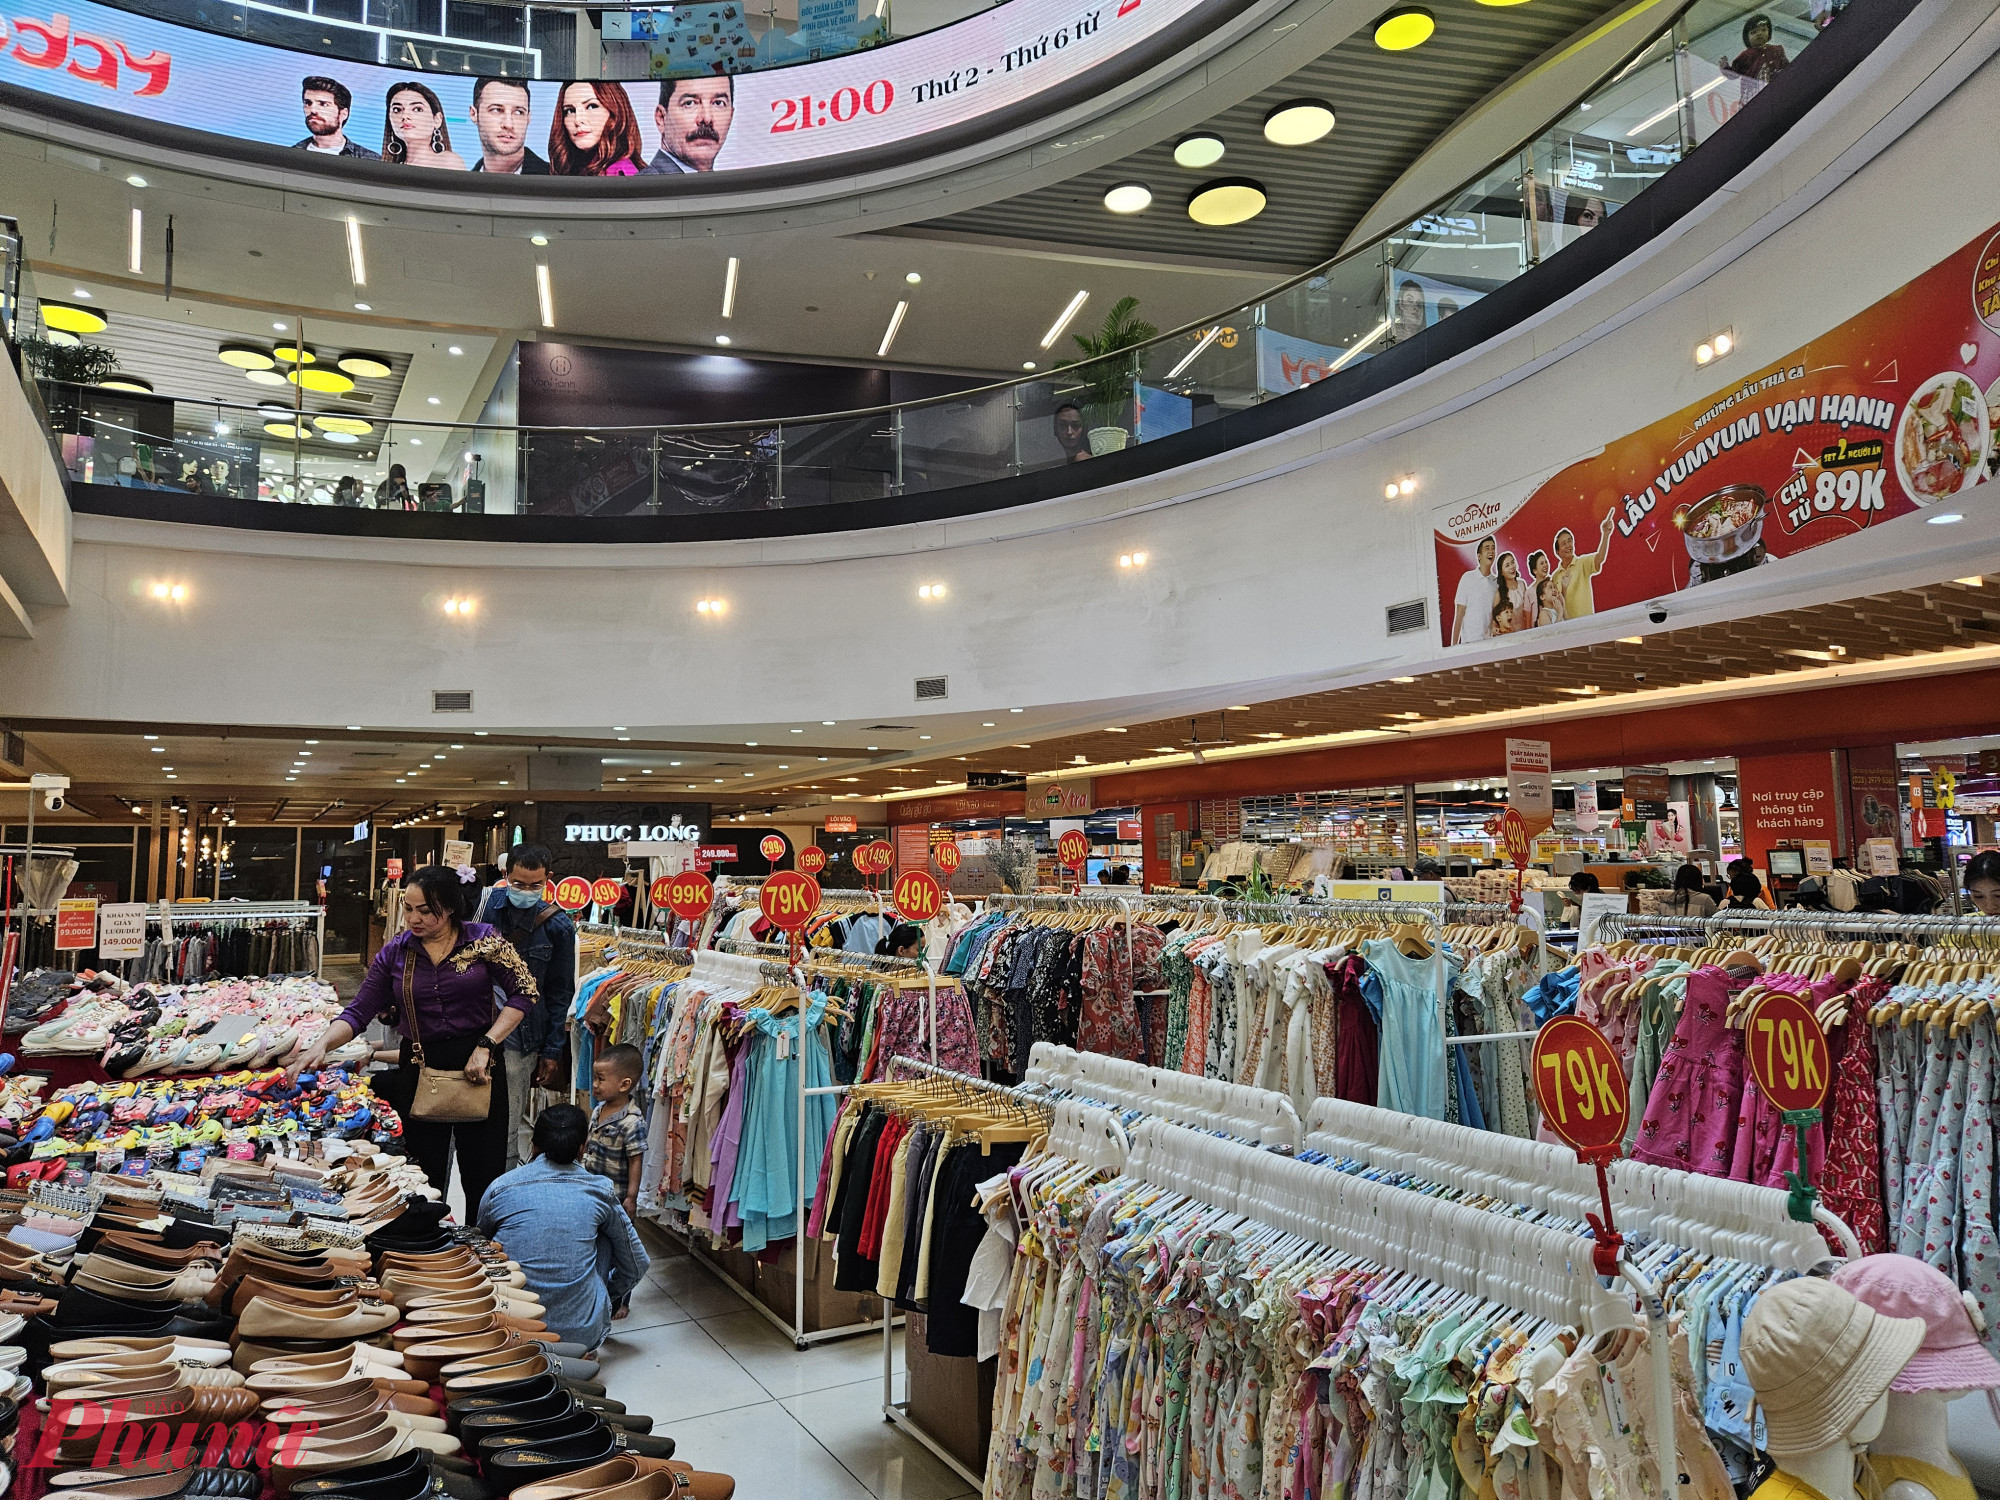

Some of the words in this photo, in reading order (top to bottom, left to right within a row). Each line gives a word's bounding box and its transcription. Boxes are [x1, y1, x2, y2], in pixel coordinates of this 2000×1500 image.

[770, 79, 894, 133] 21:00
[911, 72, 960, 103] Thứ
[965, 67, 979, 88] 2
[1001, 36, 1048, 73] Thứ
[1054, 28, 1069, 49] 6
[1075, 10, 1101, 40] từ
[1787, 365, 1805, 380] GA
[1823, 453, 1836, 463] SET
[1837, 438, 1848, 460] 2
[1617, 487, 1656, 537] LẨU
[1655, 412, 1761, 494] YUMYUM
[1764, 397, 1816, 433] VẠN
[1821, 394, 1895, 431] HẠNH
[1780, 469, 1808, 506] CHỈ
[1814, 468, 1887, 512] 89K
[1788, 497, 1812, 527] TỪ
[1455, 519, 1475, 539] VẠN
[1473, 517, 1498, 533] HẠNH
[1752, 792, 1772, 802] Nơi
[1775, 791, 1799, 804] truy
[1802, 788, 1825, 801] cập
[1760, 804, 1795, 816] thông
[1798, 802, 1814, 813] tin
[639, 824, 700, 841] LONG
[1757, 818, 1791, 828] khách
[1794, 817, 1825, 828] hàng
[763, 840, 784, 854] 299k
[1506, 820, 1529, 855] 99k
[869, 849, 892, 865] 149K
[936, 847, 958, 866] 149k
[1061, 837, 1084, 862] 99k
[800, 853, 822, 867] 199K
[854, 854, 866, 868] 14
[559, 882, 587, 904] 99k
[594, 882, 618, 902] 49k
[672, 884, 709, 904] 99K
[766, 883, 809, 915] 79K
[898, 878, 934, 914] 49k
[124, 911, 141, 919] NAM
[60, 928, 92, 936] 99.000đ
[103, 937, 143, 946] 149.000đ
[1757, 1018, 1823, 1090] 79k
[1541, 1046, 1623, 1124] 79k
